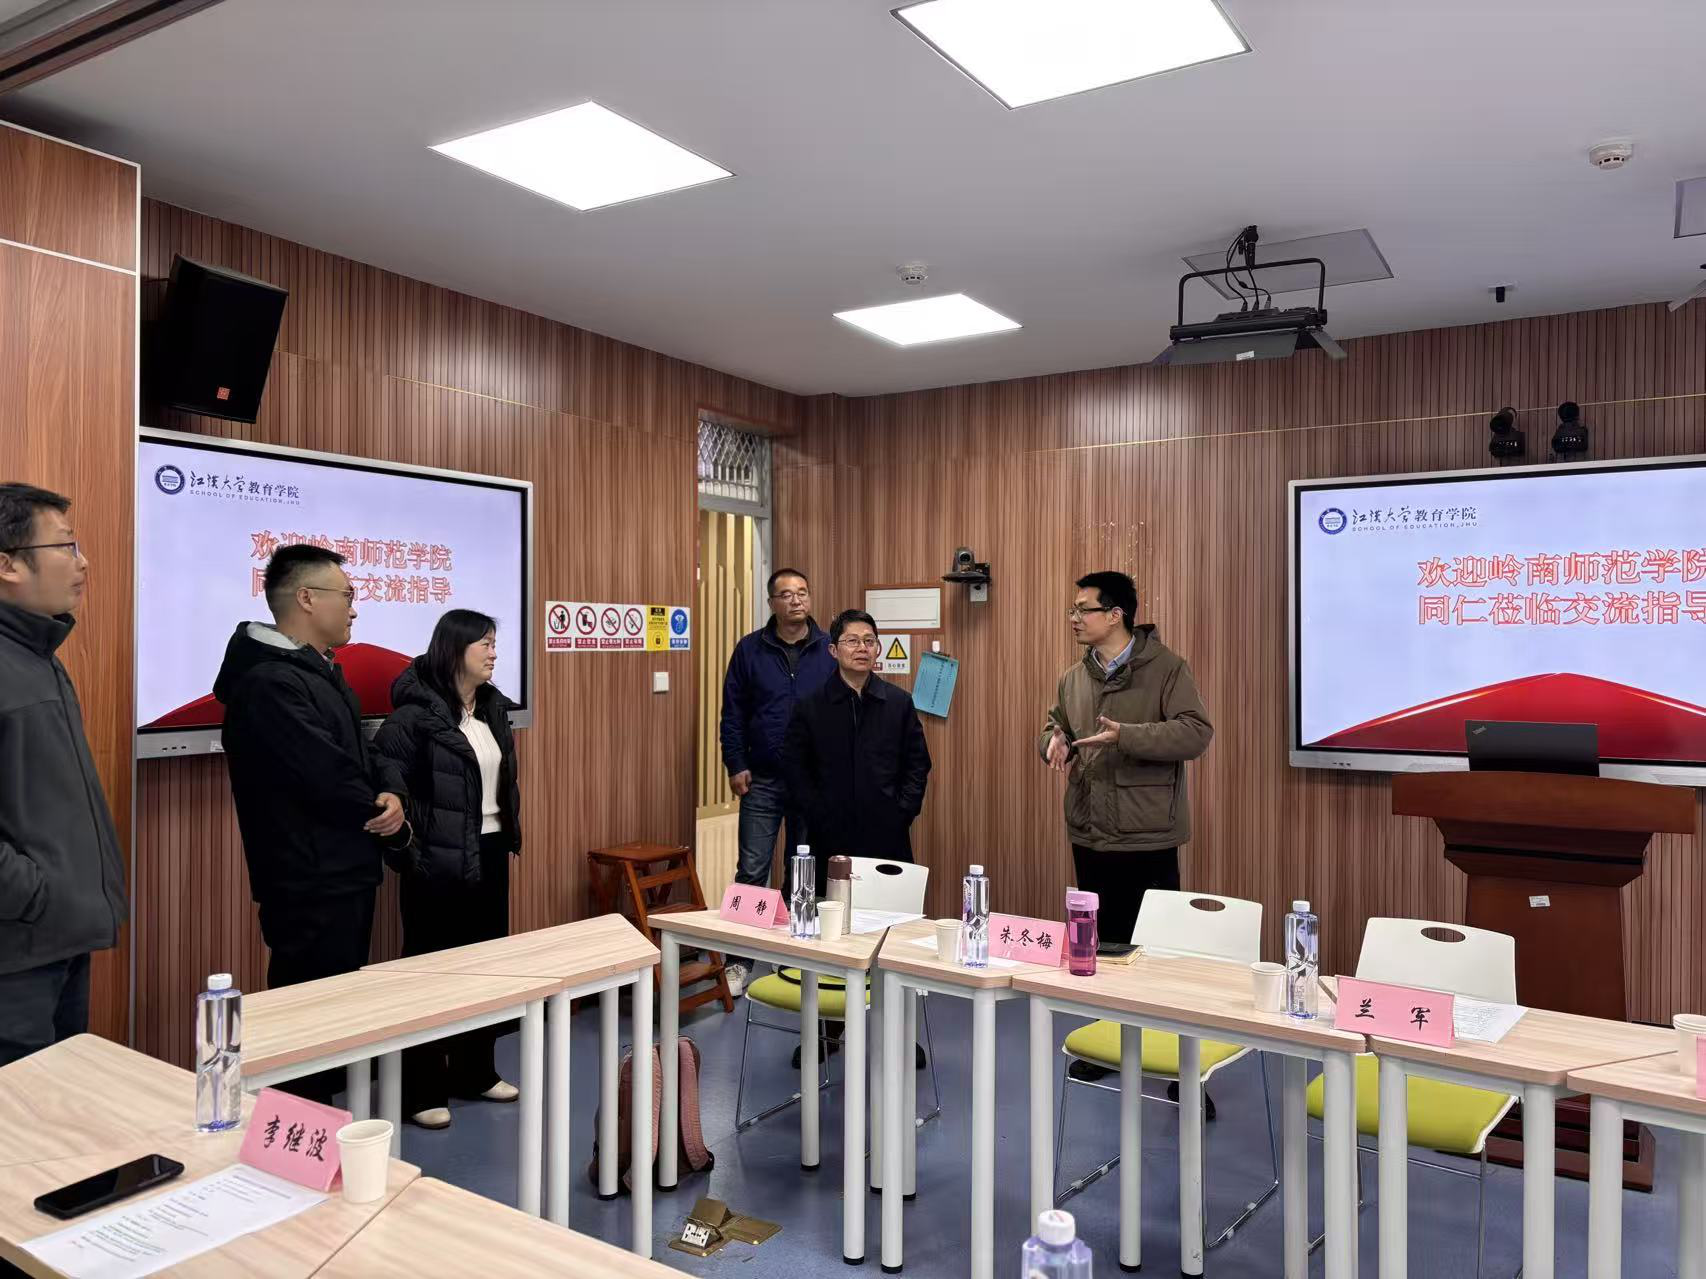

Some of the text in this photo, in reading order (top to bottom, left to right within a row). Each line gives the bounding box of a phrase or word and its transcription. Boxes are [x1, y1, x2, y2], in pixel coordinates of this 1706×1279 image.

[252, 567, 452, 604] 交流指导
[1417, 548, 1706, 588] 欢迎岭南师范学院
[1418, 590, 1706, 625] 同仁莅临交流指导
[1000, 925, 1053, 950] 朱冬梅
[1355, 998, 1431, 1031] 兰军
[264, 1114, 328, 1162] 李继波
